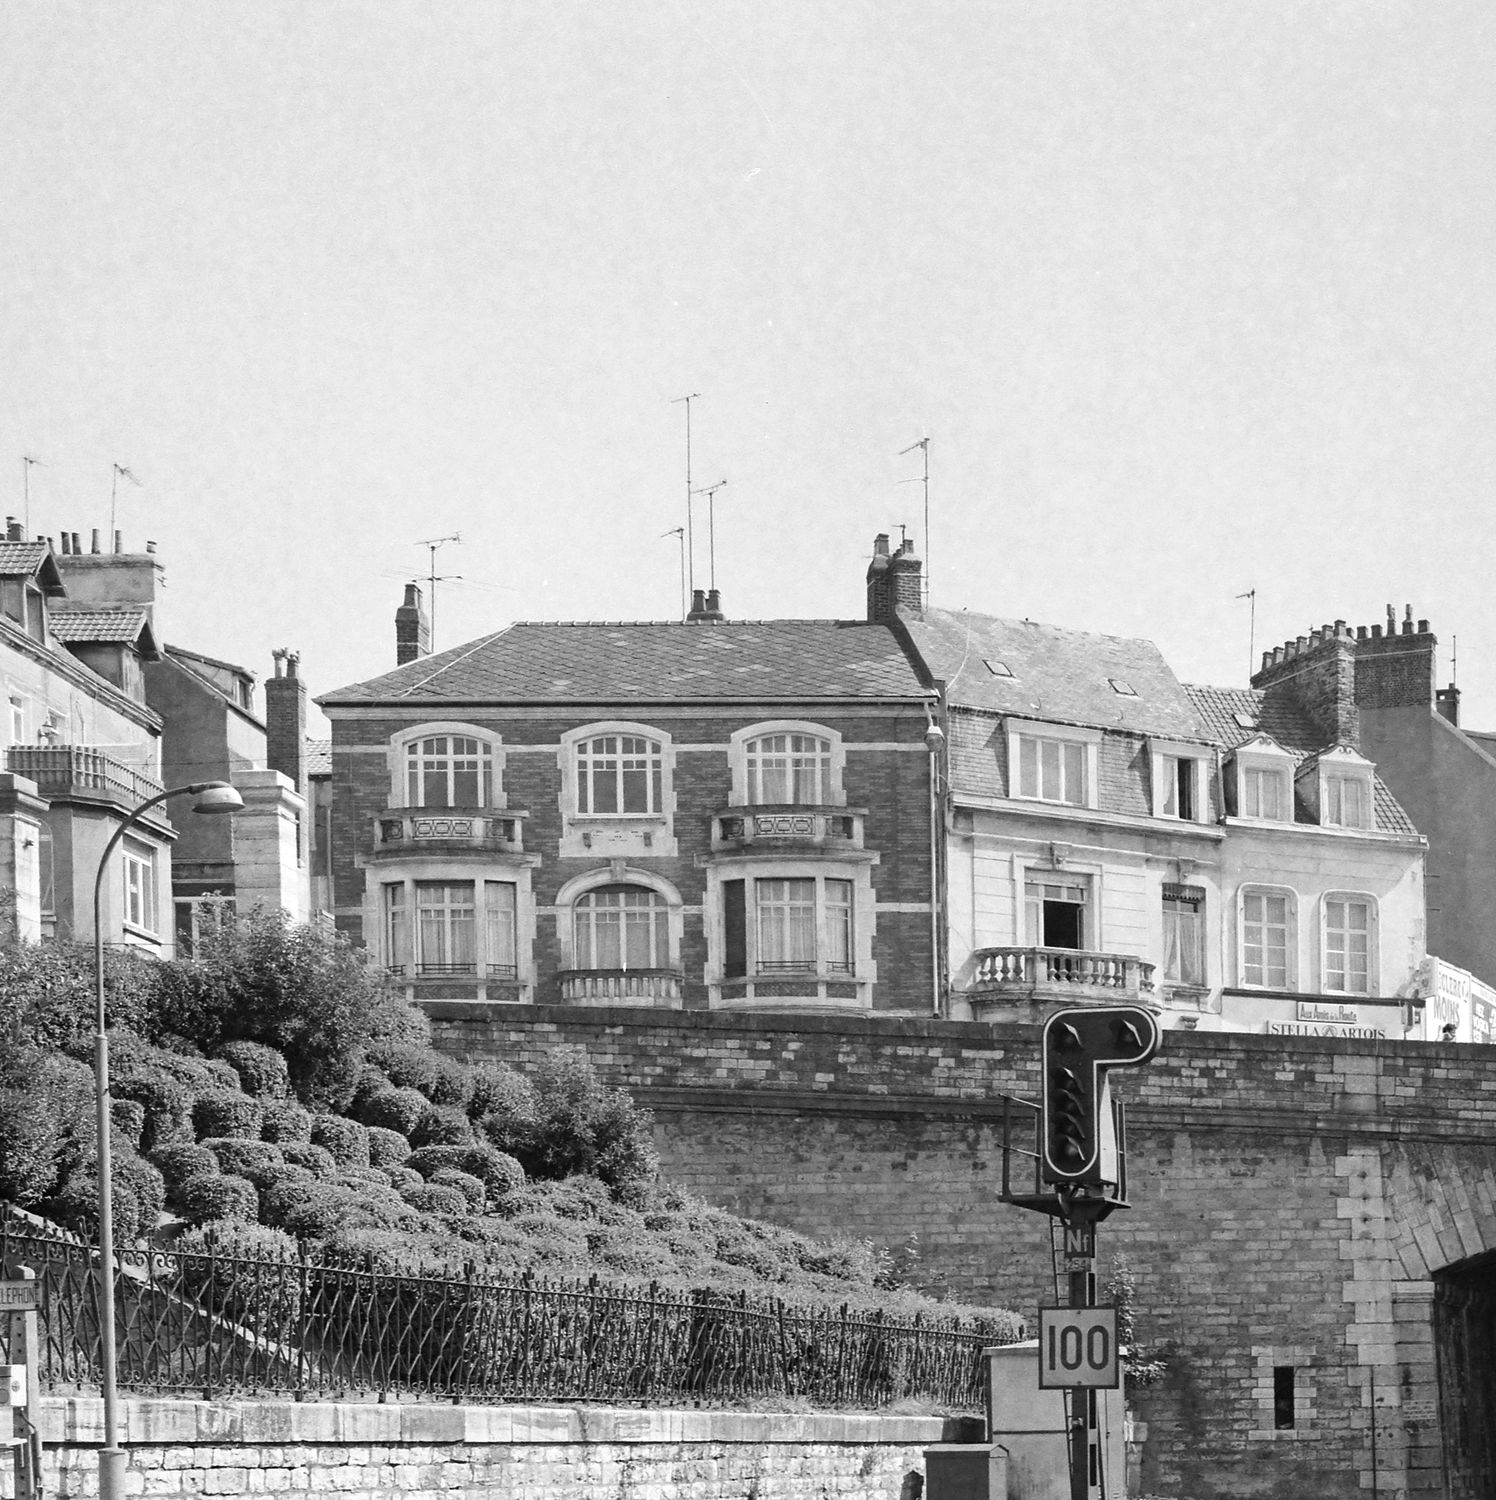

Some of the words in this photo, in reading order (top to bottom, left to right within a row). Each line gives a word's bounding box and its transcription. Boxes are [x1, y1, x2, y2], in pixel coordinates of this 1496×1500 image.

[1271, 1023, 1320, 1037] STELLA
[1341, 1027, 1386, 1040] ARTOIS
[1067, 1229, 1089, 1252] Nf
[0, 1286, 40, 1304] LEPHONE
[1049, 1325, 1109, 1370] 100
